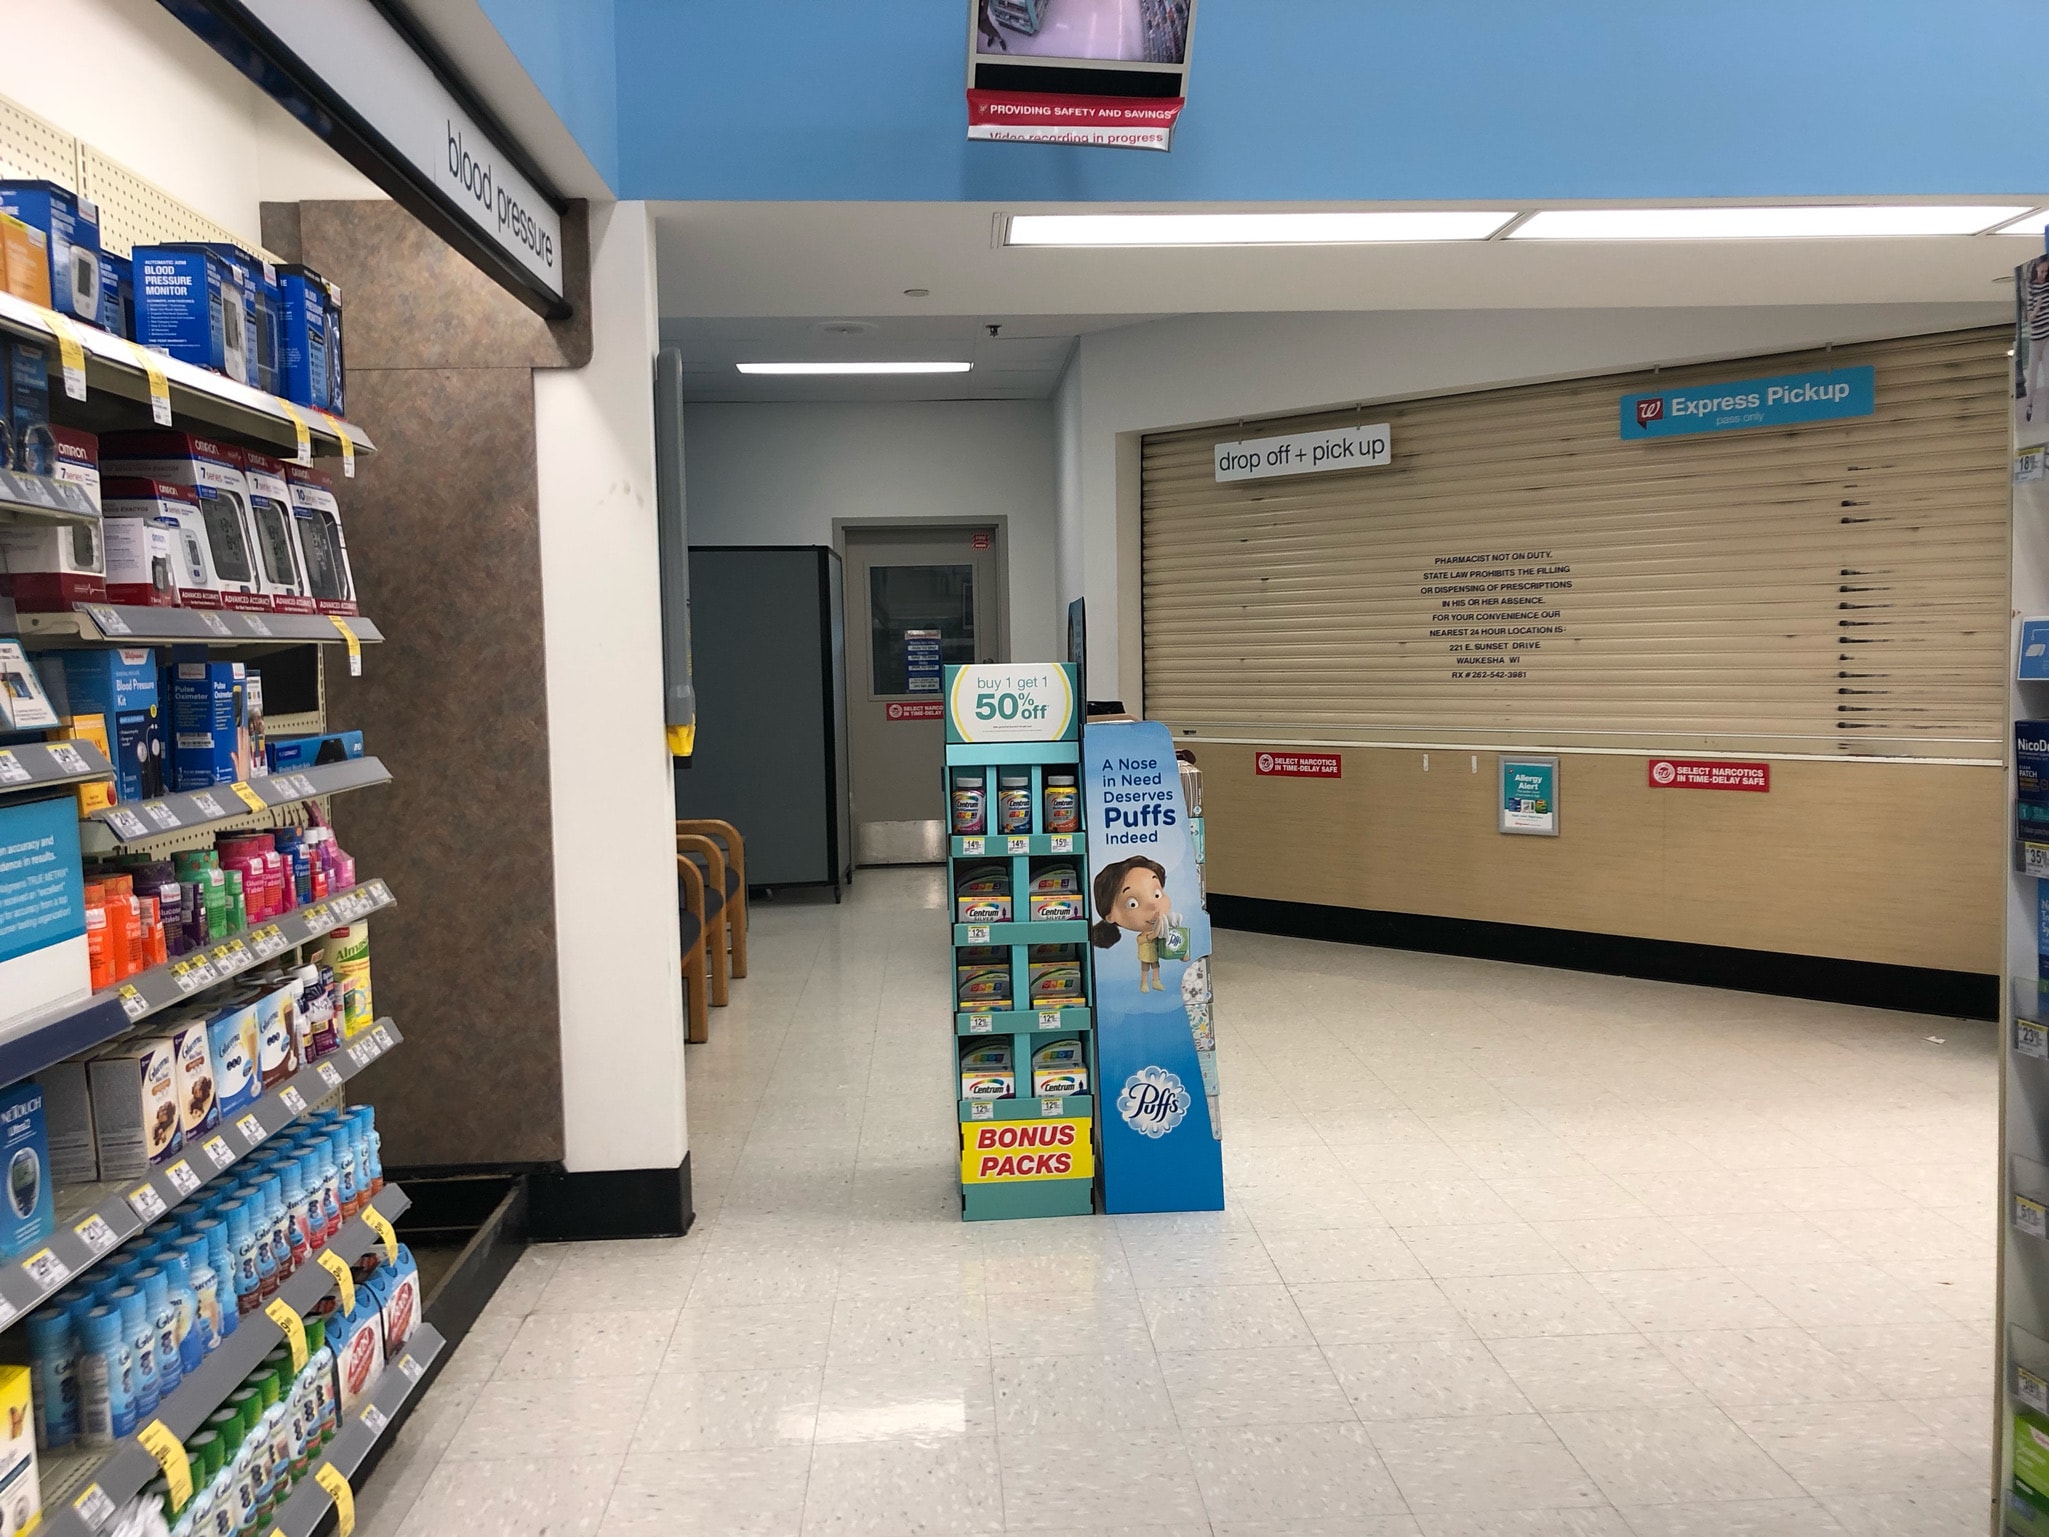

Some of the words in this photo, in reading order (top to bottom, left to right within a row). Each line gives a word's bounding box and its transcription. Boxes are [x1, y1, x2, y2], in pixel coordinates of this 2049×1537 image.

[990, 104, 1051, 116] PROVIDING
[1054, 107, 1096, 117] SAFETY
[1098, 109, 1122, 118] AND
[1124, 111, 1172, 120] SAVINGS
[1093, 133, 1104, 143] in
[1107, 134, 1164, 146] progress
[447, 119, 492, 212] blood
[497, 185, 553, 268] pressure
[144, 266, 175, 275] BLOOD
[145, 275, 193, 287] PRESSURE
[145, 286, 188, 296] MONITOR
[1672, 392, 1760, 418] Express
[1767, 382, 1850, 406] Pickup
[1716, 414, 1741, 427] pass
[1743, 411, 1765, 423] only
[1219, 452, 1261, 472] drop
[1266, 444, 1291, 466] off
[1313, 437, 1354, 466] pick
[1359, 437, 1385, 459] up
[1434, 554, 1490, 565] PHARMACIST
[1491, 553, 1510, 562] NOT
[1512, 552, 1525, 561] ON
[1526, 551, 1553, 560] DUTY.
[1423, 571, 1449, 581] STATE
[1450, 570, 1469, 579] LAW
[1469, 568, 1516, 579] PROHIBITS
[1517, 567, 1535, 576] THE
[1537, 565, 1571, 575] FILLING
[1420, 586, 1433, 595] OR
[1434, 584, 1486, 594] DISPENSING
[1487, 583, 1499, 592] OF
[1500, 580, 1573, 591] PRESCRIPTIONS
[1442, 600, 1450, 608] IN
[1452, 599, 1466, 607] HIS
[1468, 598, 1480, 607] OR
[1481, 598, 1499, 606] HER
[1500, 596, 1546, 605] ABSENCE.
[1432, 614, 1450, 622] FOR
[1451, 613, 1475, 622] YOUR
[1475, 611, 1540, 621] CONVENIENCE
[1541, 610, 1561, 618] OUR
[1429, 628, 1468, 637] NEAREST
[1469, 628, 1480, 636] 24
[1480, 627, 1507, 636] HOUR
[1507, 626, 1551, 635] LOCATION
[1474, 642, 1509, 651] SUNSET
[1512, 641, 1541, 650] DRIVE
[1456, 656, 1505, 665] WAUKESHA
[1508, 656, 1520, 664] WI
[1451, 671, 1463, 679] RX
[977, 677, 1002, 691] buy
[1006, 677, 1012, 688] 1
[1017, 677, 1039, 691] get
[1043, 676, 1048, 687] 1
[1021, 704, 1047, 720] off
[1102, 759, 1114, 772] A
[1118, 757, 1158, 770] Nose
[1275, 757, 1299, 765] SELECT
[1299, 758, 1337, 766] NARCOTICS
[1282, 765, 1320, 773] TIME-DELAY
[1676, 766, 1710, 775] SELECT
[1712, 767, 1764, 777] NARCOTICS
[1103, 775, 1116, 788] in
[1121, 774, 1162, 787] Need
[1515, 774, 1543, 784] Allergy
[1676, 774, 1686, 783] IN
[1687, 775, 1740, 785] TIME-DELAY
[1742, 777, 1765, 786] SAFE
[1518, 782, 1539, 791] Alert
[1053, 799, 1074, 807] Centrum
[1103, 790, 1173, 804] Deserves
[1104, 804, 1176, 829] Puffs
[1106, 829, 1158, 845] Indeed
[969, 909, 999, 917] Centrum
[1041, 908, 1070, 917] Centrum
[973, 1086, 1004, 1094] Centrum
[1044, 1083, 1075, 1092] Centrum
[1128, 1082, 1179, 1123] Puffs
[977, 1124, 1075, 1150] BONUS
[980, 1152, 1071, 1177] PACKS
